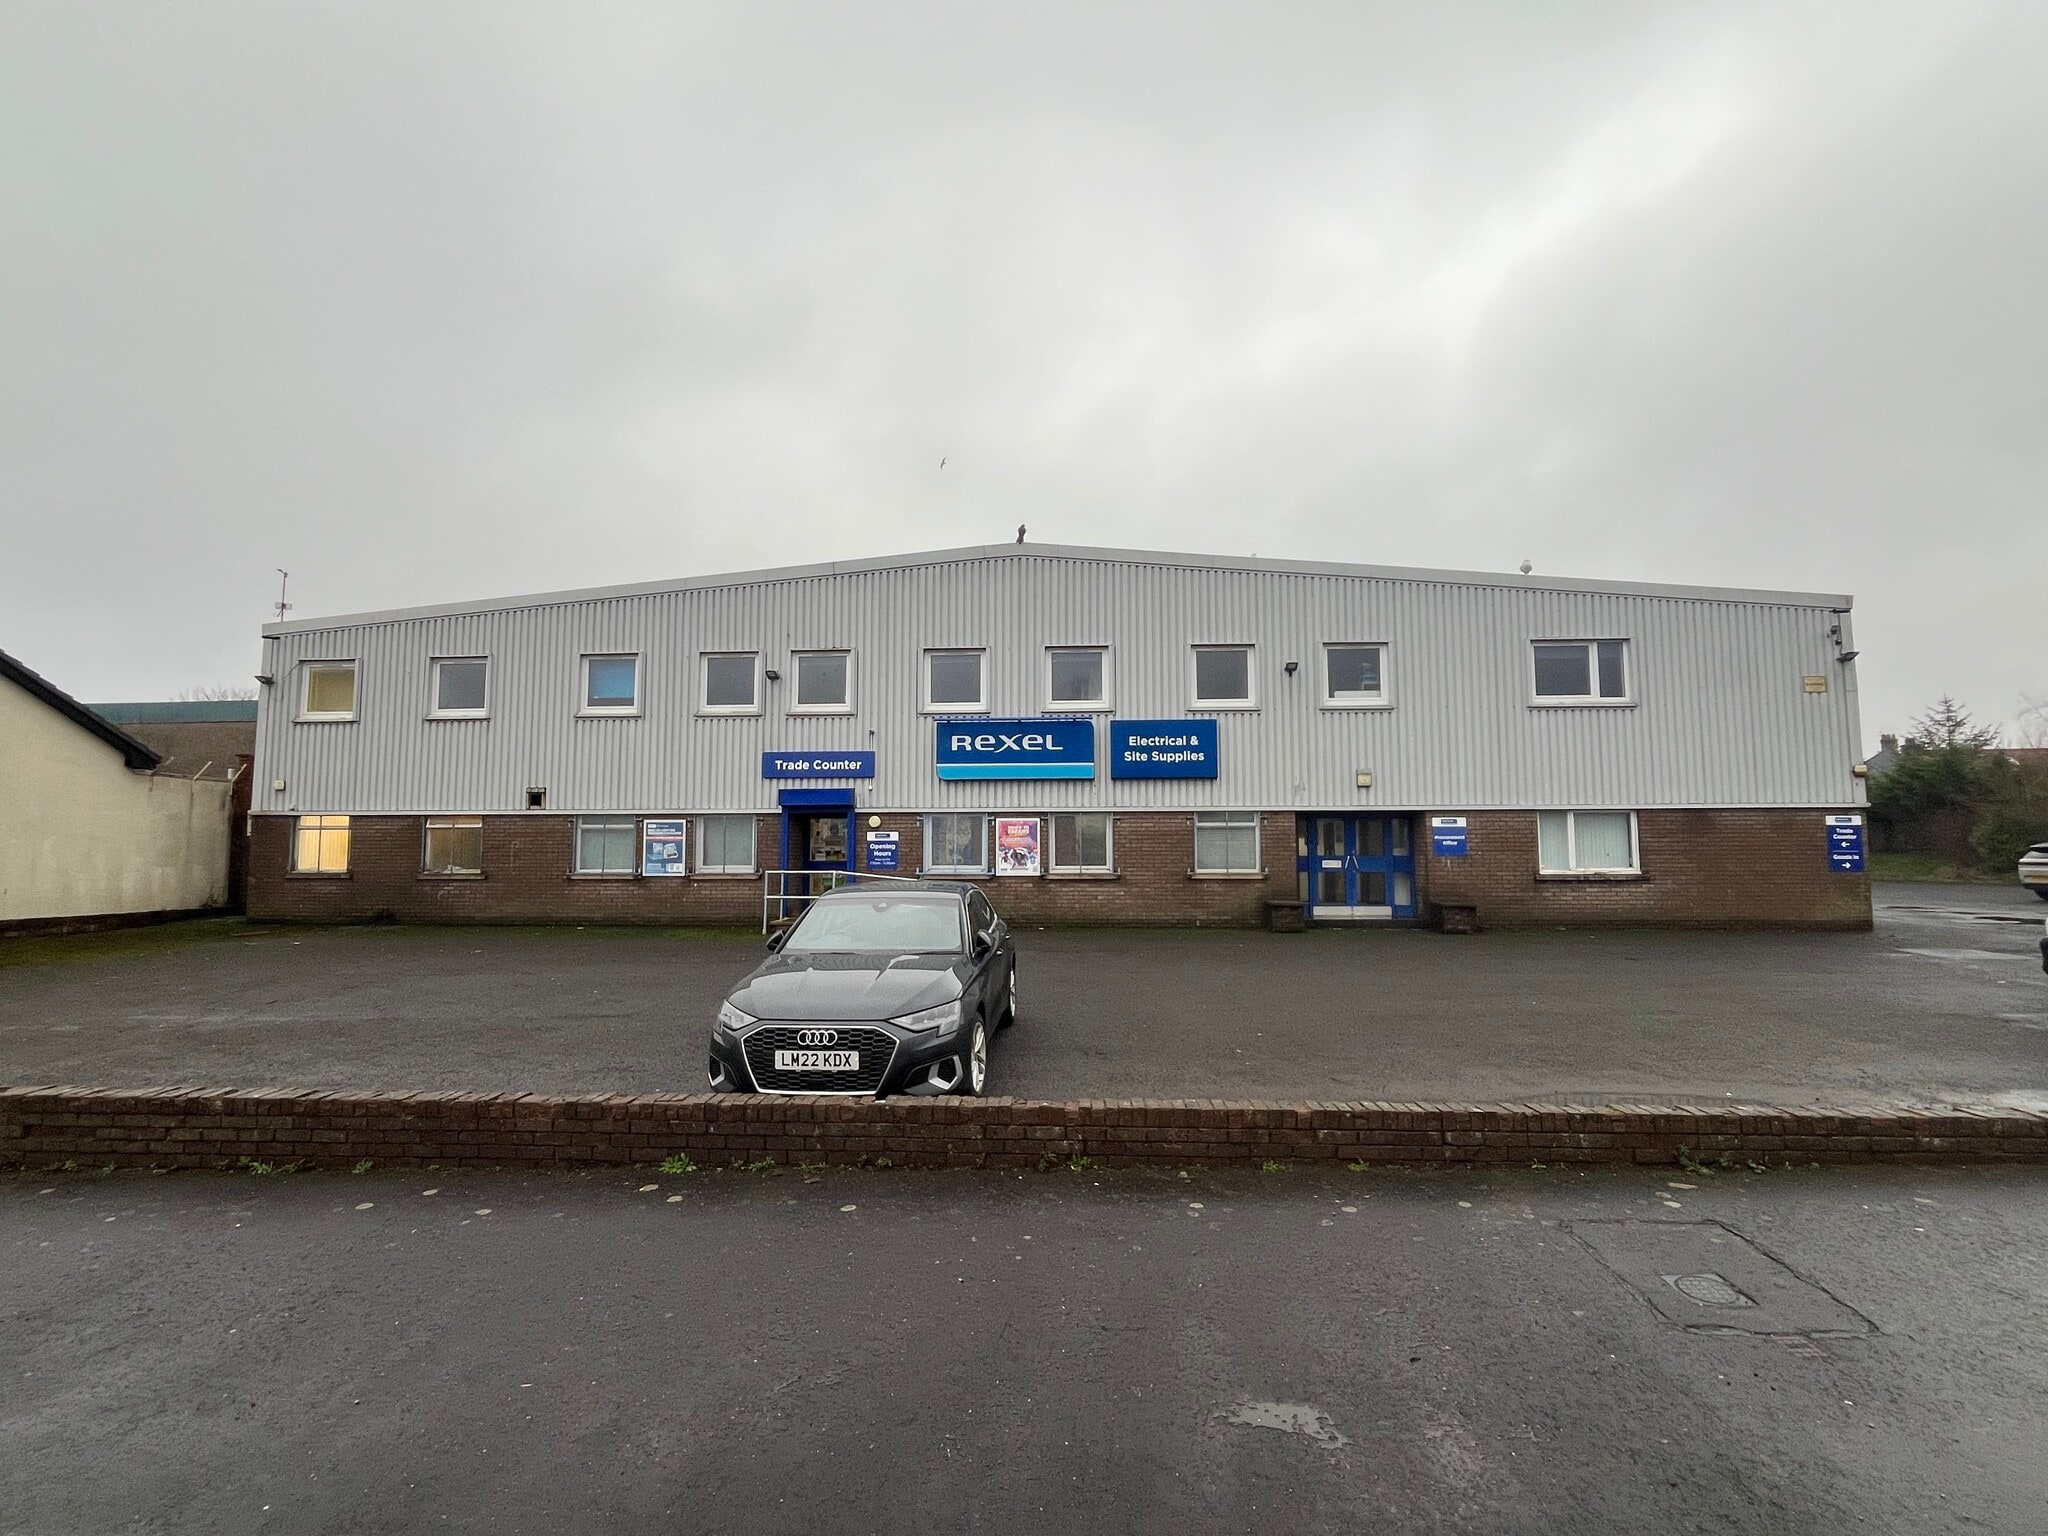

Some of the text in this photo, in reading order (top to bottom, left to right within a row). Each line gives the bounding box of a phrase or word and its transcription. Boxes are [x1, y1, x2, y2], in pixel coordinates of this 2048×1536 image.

[1128, 735, 1199, 746] Electrical &
[1124, 750, 1205, 763] Site Supplies
[775, 760, 862, 770] Trade Counter
[781, 1052, 852, 1067] LM22 KDX
